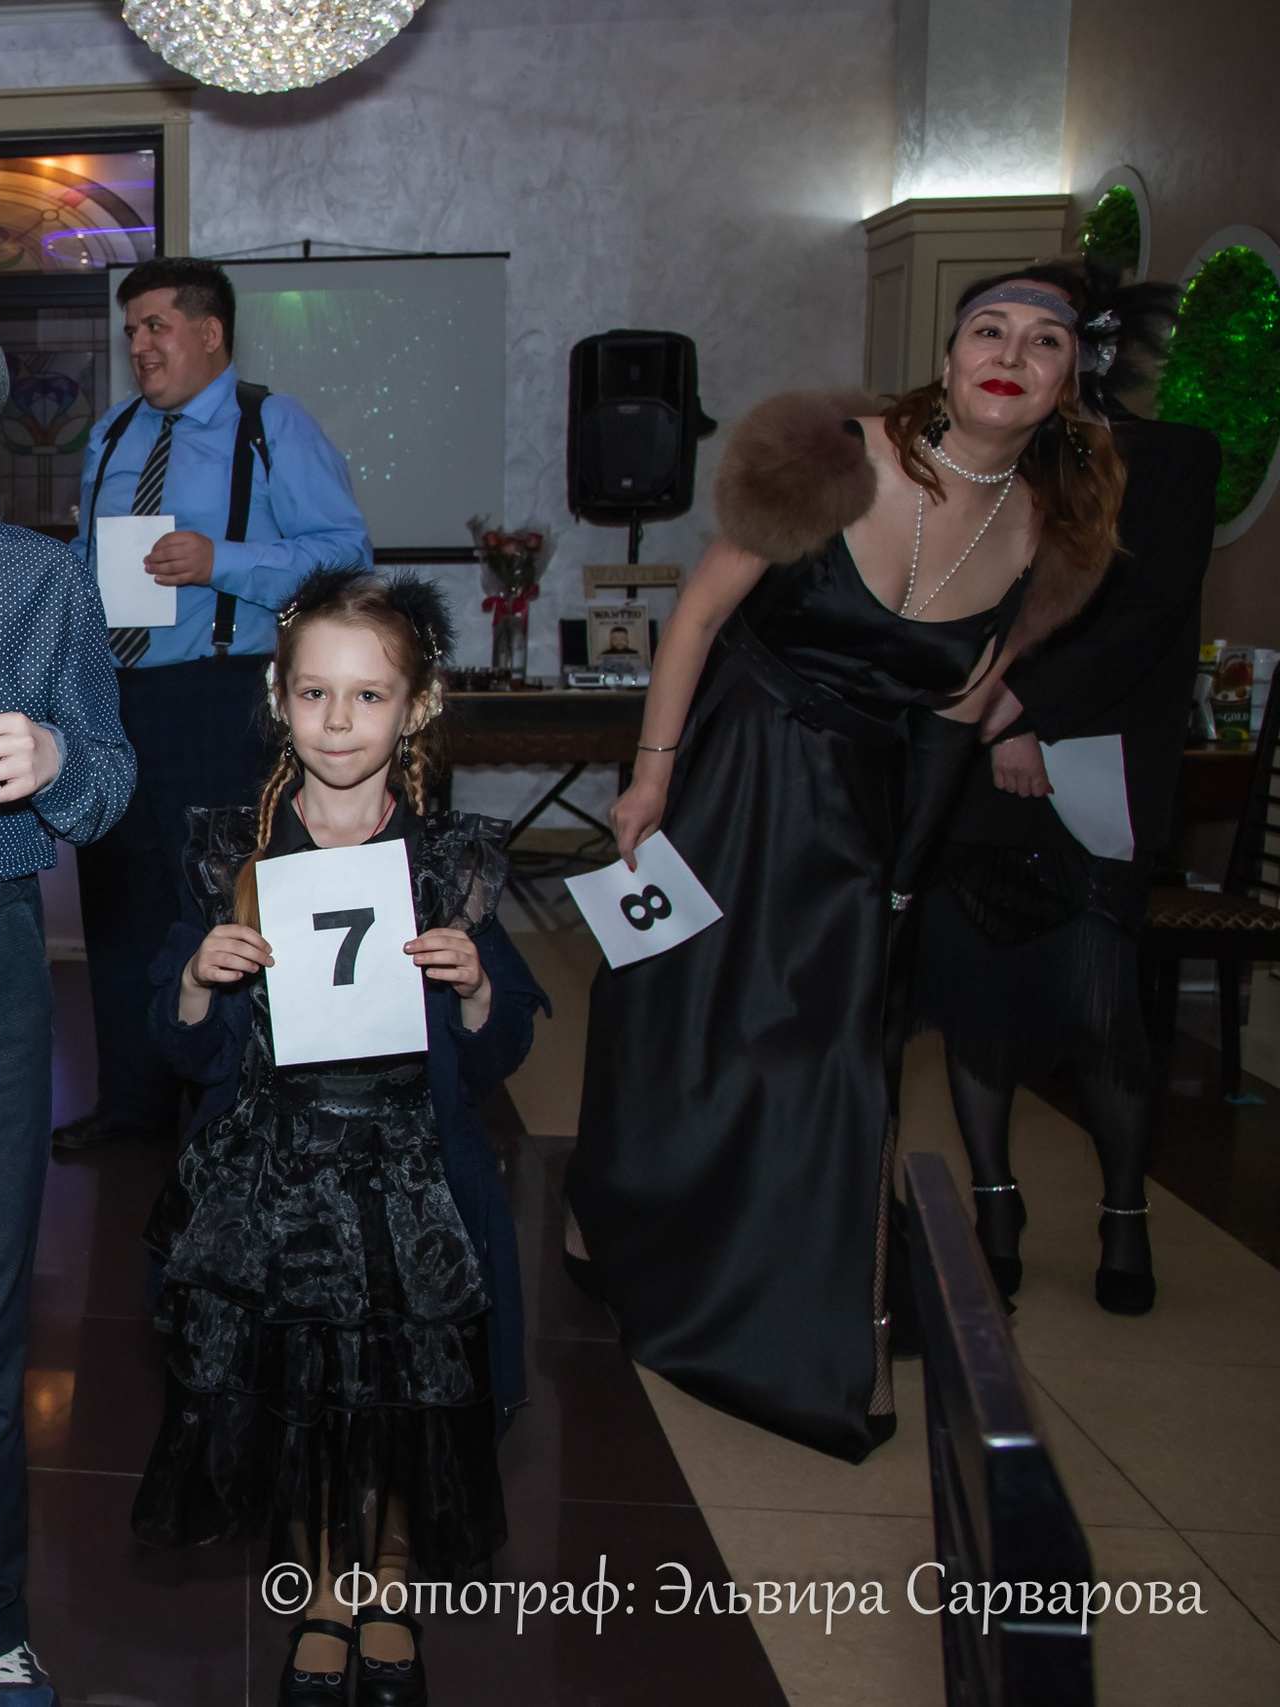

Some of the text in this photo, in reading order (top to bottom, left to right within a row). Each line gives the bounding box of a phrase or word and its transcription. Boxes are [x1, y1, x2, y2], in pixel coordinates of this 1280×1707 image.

[593, 610, 642, 620] WANTED
[620, 884, 673, 932] 8
[312, 907, 376, 987] 7
